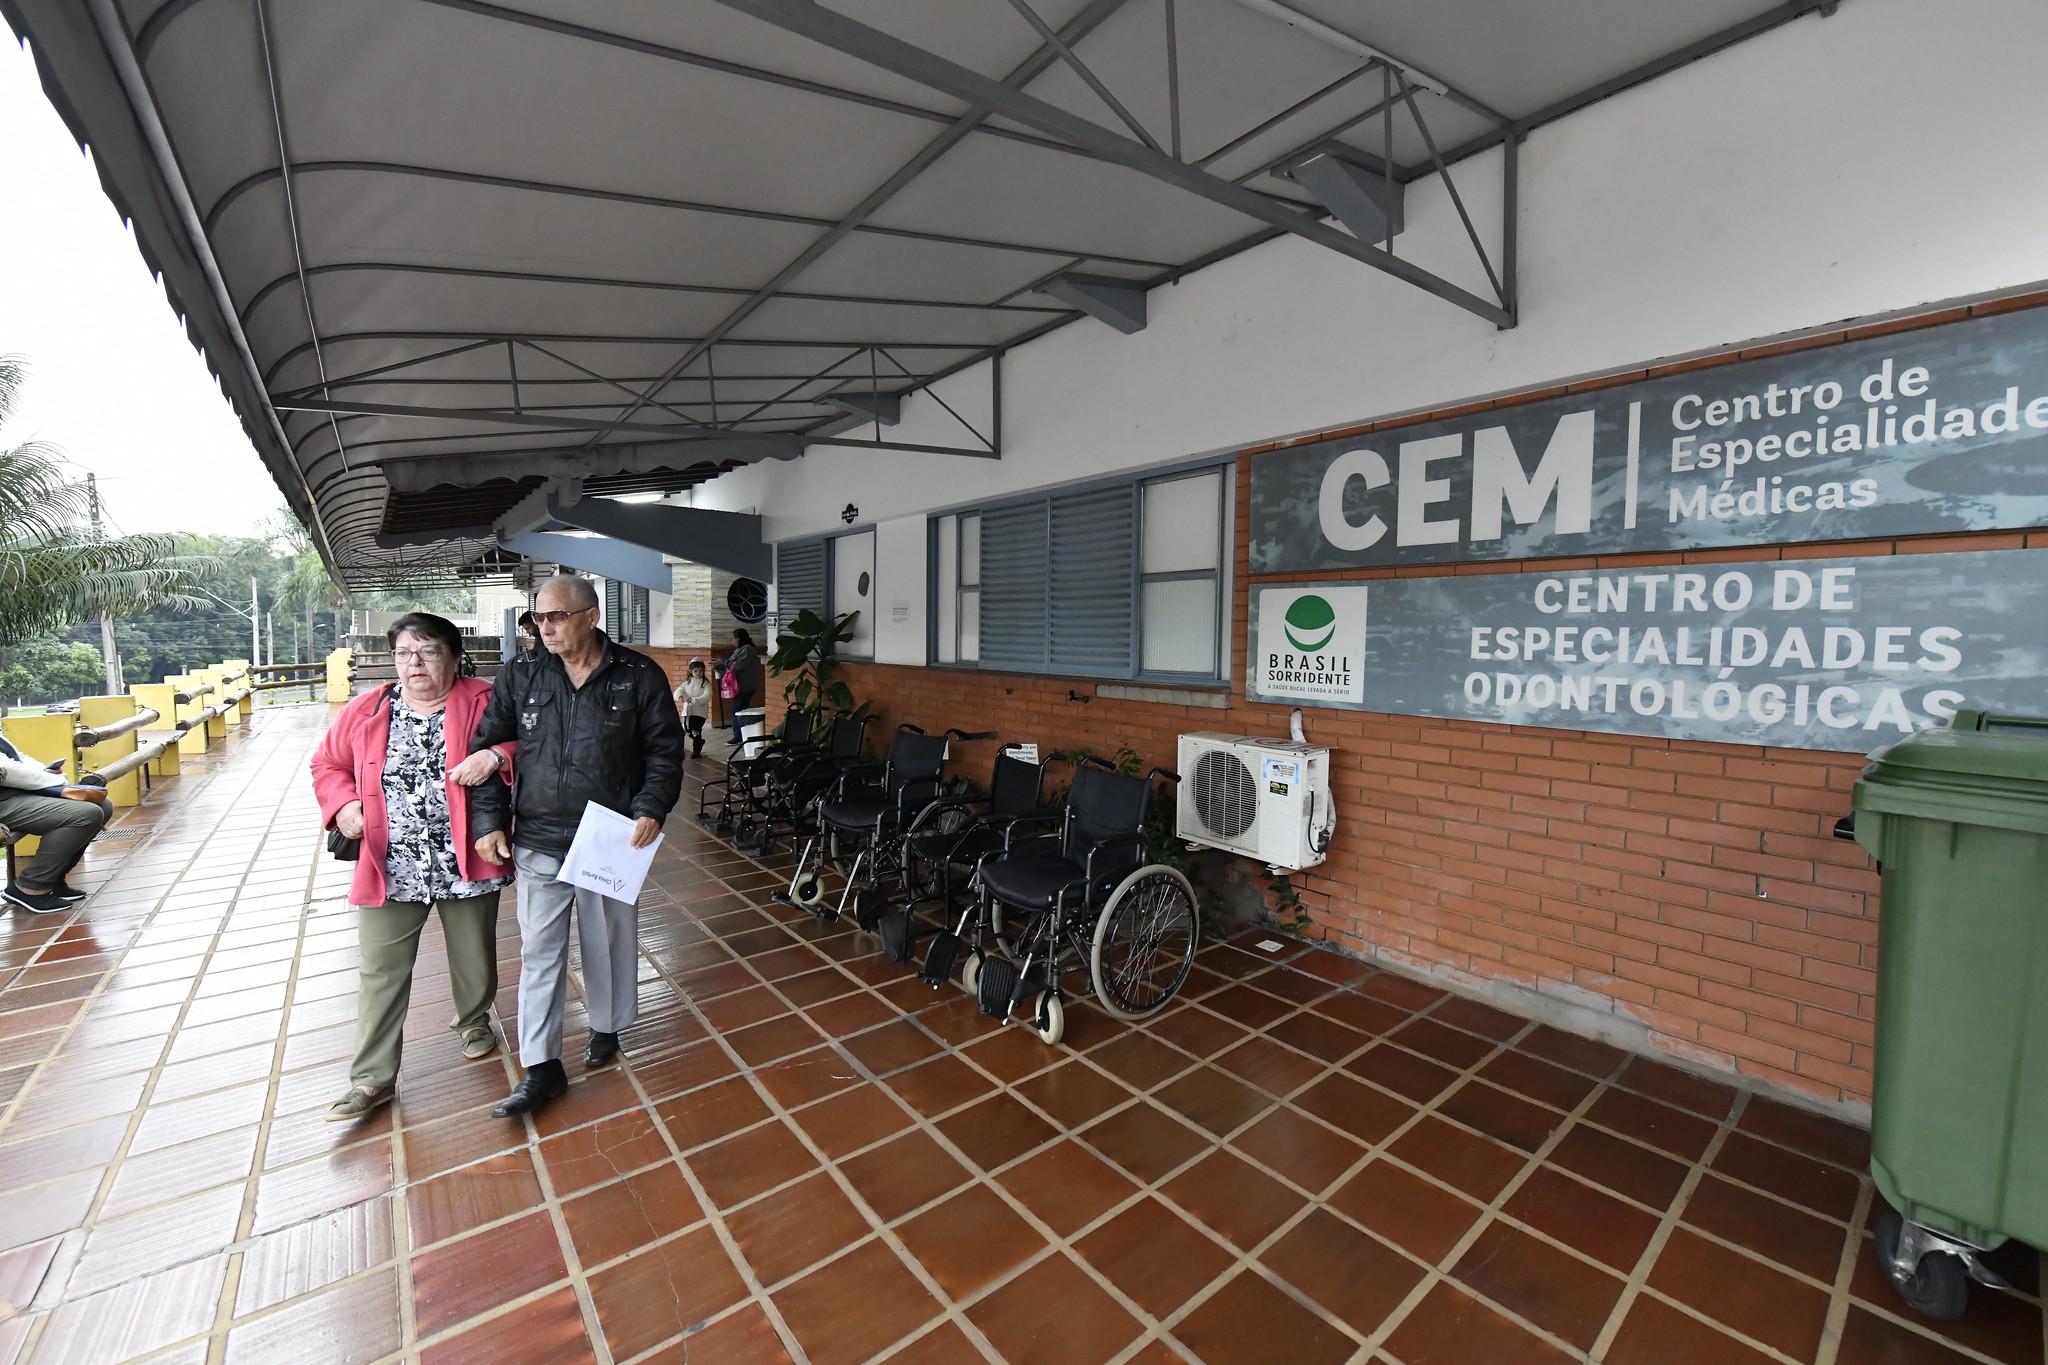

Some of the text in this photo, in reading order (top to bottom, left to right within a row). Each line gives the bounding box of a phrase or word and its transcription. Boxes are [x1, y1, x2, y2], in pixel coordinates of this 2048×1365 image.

[1671, 358, 1931, 431] Centro de
[1670, 386, 2048, 478] Especialidade
[1318, 409, 1596, 551] CEM
[1668, 476, 1879, 523] Médicas
[1534, 567, 1856, 614] CENTRO DE
[1269, 653, 1350, 672] BRASIL
[1470, 626, 1963, 672] ESPECIALIDADES
[1268, 669, 1350, 686] SORRIDENTE
[1463, 667, 1966, 733] ODONTOLÓGICAS
